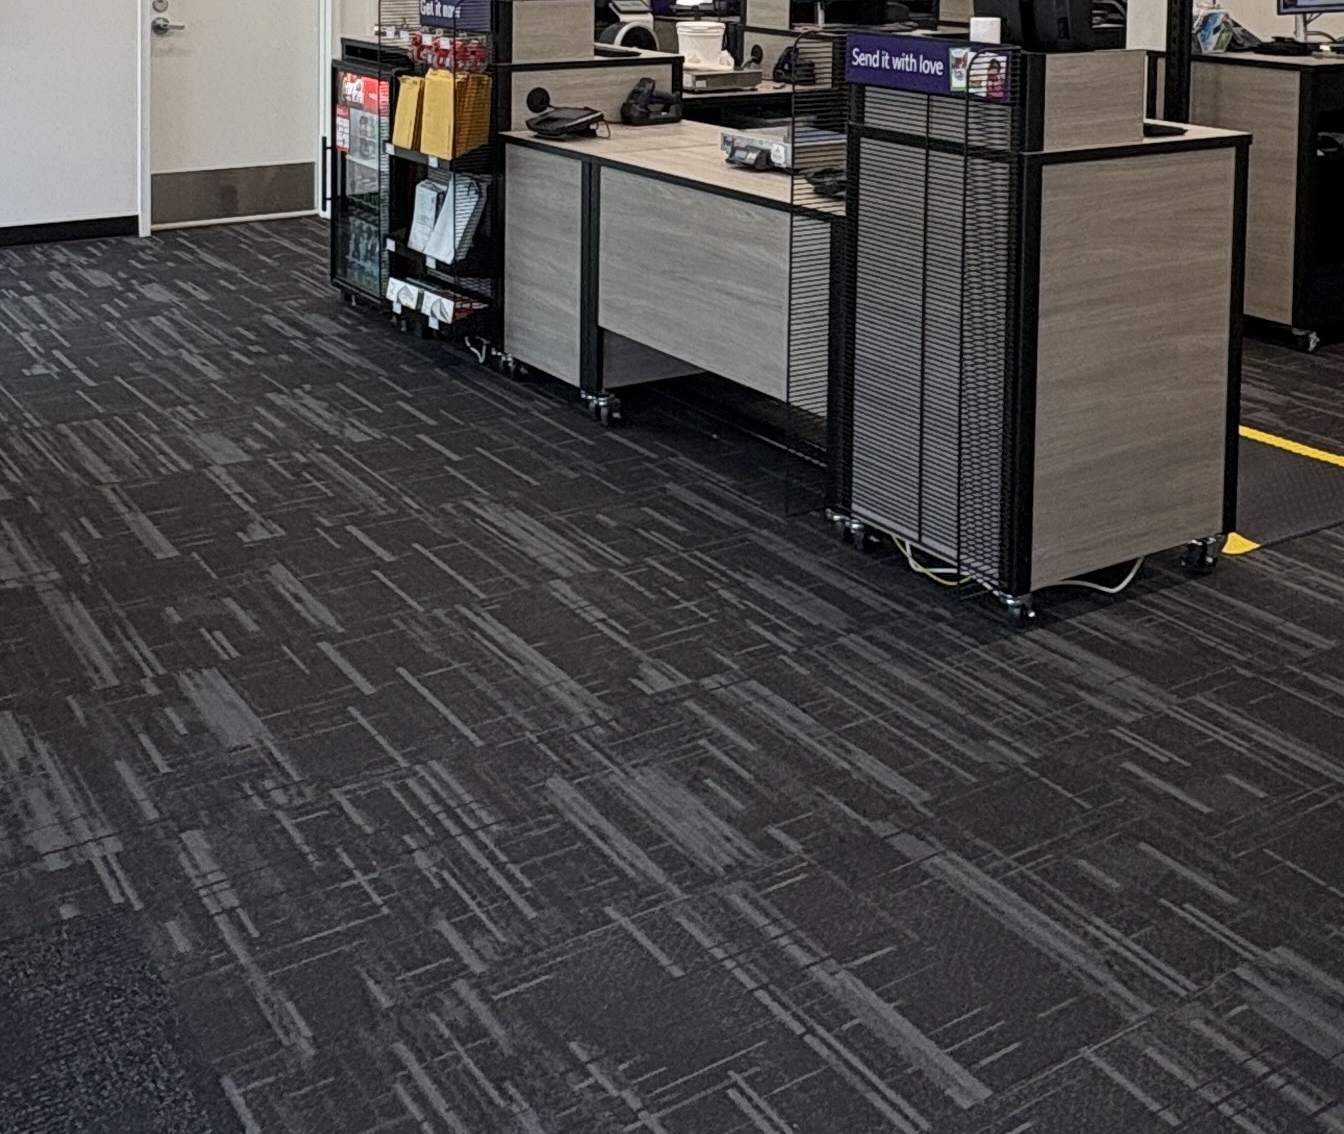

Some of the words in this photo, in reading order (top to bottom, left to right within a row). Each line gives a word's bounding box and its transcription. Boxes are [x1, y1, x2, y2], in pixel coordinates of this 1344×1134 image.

[435, 0, 442, 17] it
[852, 47, 880, 67] Send
[882, 50, 890, 69] it
[892, 53, 917, 72] with
[919, 55, 944, 76] love
